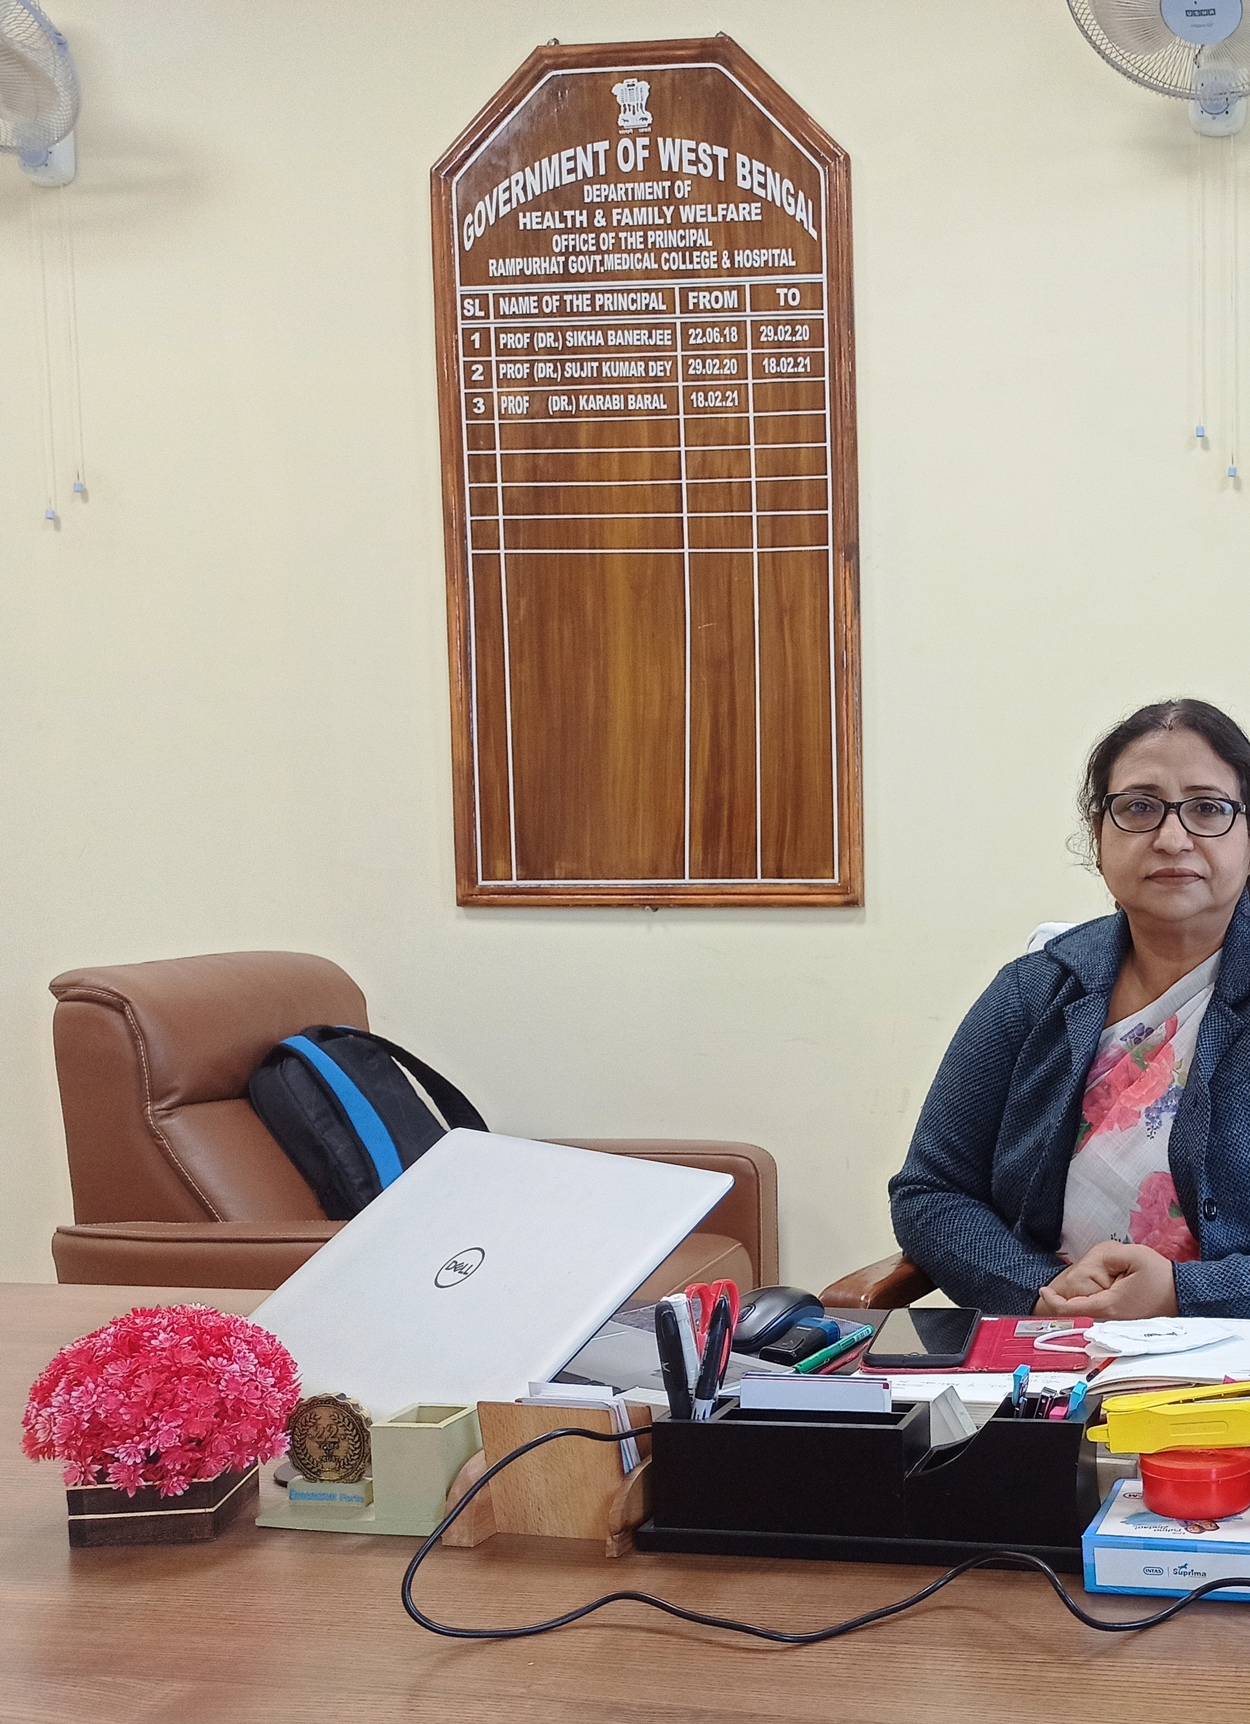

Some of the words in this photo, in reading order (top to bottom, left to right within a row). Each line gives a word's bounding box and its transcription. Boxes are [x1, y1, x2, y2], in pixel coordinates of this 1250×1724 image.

[463, 140, 609, 251] GOVERNMENT
[617, 137, 650, 173] OF
[658, 137, 728, 181] WEST
[736, 154, 817, 241] BENGAL
[583, 181, 672, 203] DEPARTMENT
[674, 180, 692, 198] OF
[518, 210, 585, 230] HEALTH
[594, 210, 606, 227] &
[612, 205, 675, 227] FAMILY
[678, 203, 762, 223] WELFARE
[552, 234, 597, 253] OFFICE
[600, 233, 616, 251] OF
[618, 232, 644, 249] THE
[647, 229, 713, 248] PRINCIPAL
[489, 256, 565, 276] RAMPURHAT
[661, 251, 718, 271] COLLEGE
[722, 252, 731, 268] &
[734, 248, 795, 268] HOSPITAL
[500, 297, 538, 315] NAME
[543, 295, 560, 313] OF
[563, 294, 591, 312] THE
[596, 292, 666, 312] PRINCIPAL
[688, 291, 738, 309] FROM
[776, 288, 801, 306] TO
[464, 299, 484, 317] SL
[471, 332, 481, 349] 1
[500, 333, 530, 349] PROF
[534, 332, 563, 351] (DR.)
[566, 330, 604, 347] SIKHA
[608, 328, 672, 346] BANERJEE
[688, 327, 738, 344] 22.06.18
[760, 325, 809, 342] 29.02.20
[471, 364, 484, 381] 2
[499, 363, 530, 379] PROF
[534, 362, 562, 381] (DR.)
[565, 361, 598, 378] SUJIT
[602, 360, 645, 377] KUMAR
[649, 360, 672, 376] DEY
[688, 359, 737, 375] 29.02.20
[763, 356, 811, 373] 18.02.21
[472, 398, 485, 414] 3
[501, 397, 529, 414] PROF
[548, 396, 576, 415] (DR.)
[579, 395, 624, 411] KARABI
[627, 393, 667, 410] BARAL
[691, 391, 739, 407] 18.02.21
[445, 1260, 473, 1275] DELL
[1173, 1567, 1207, 1578] Suprima
